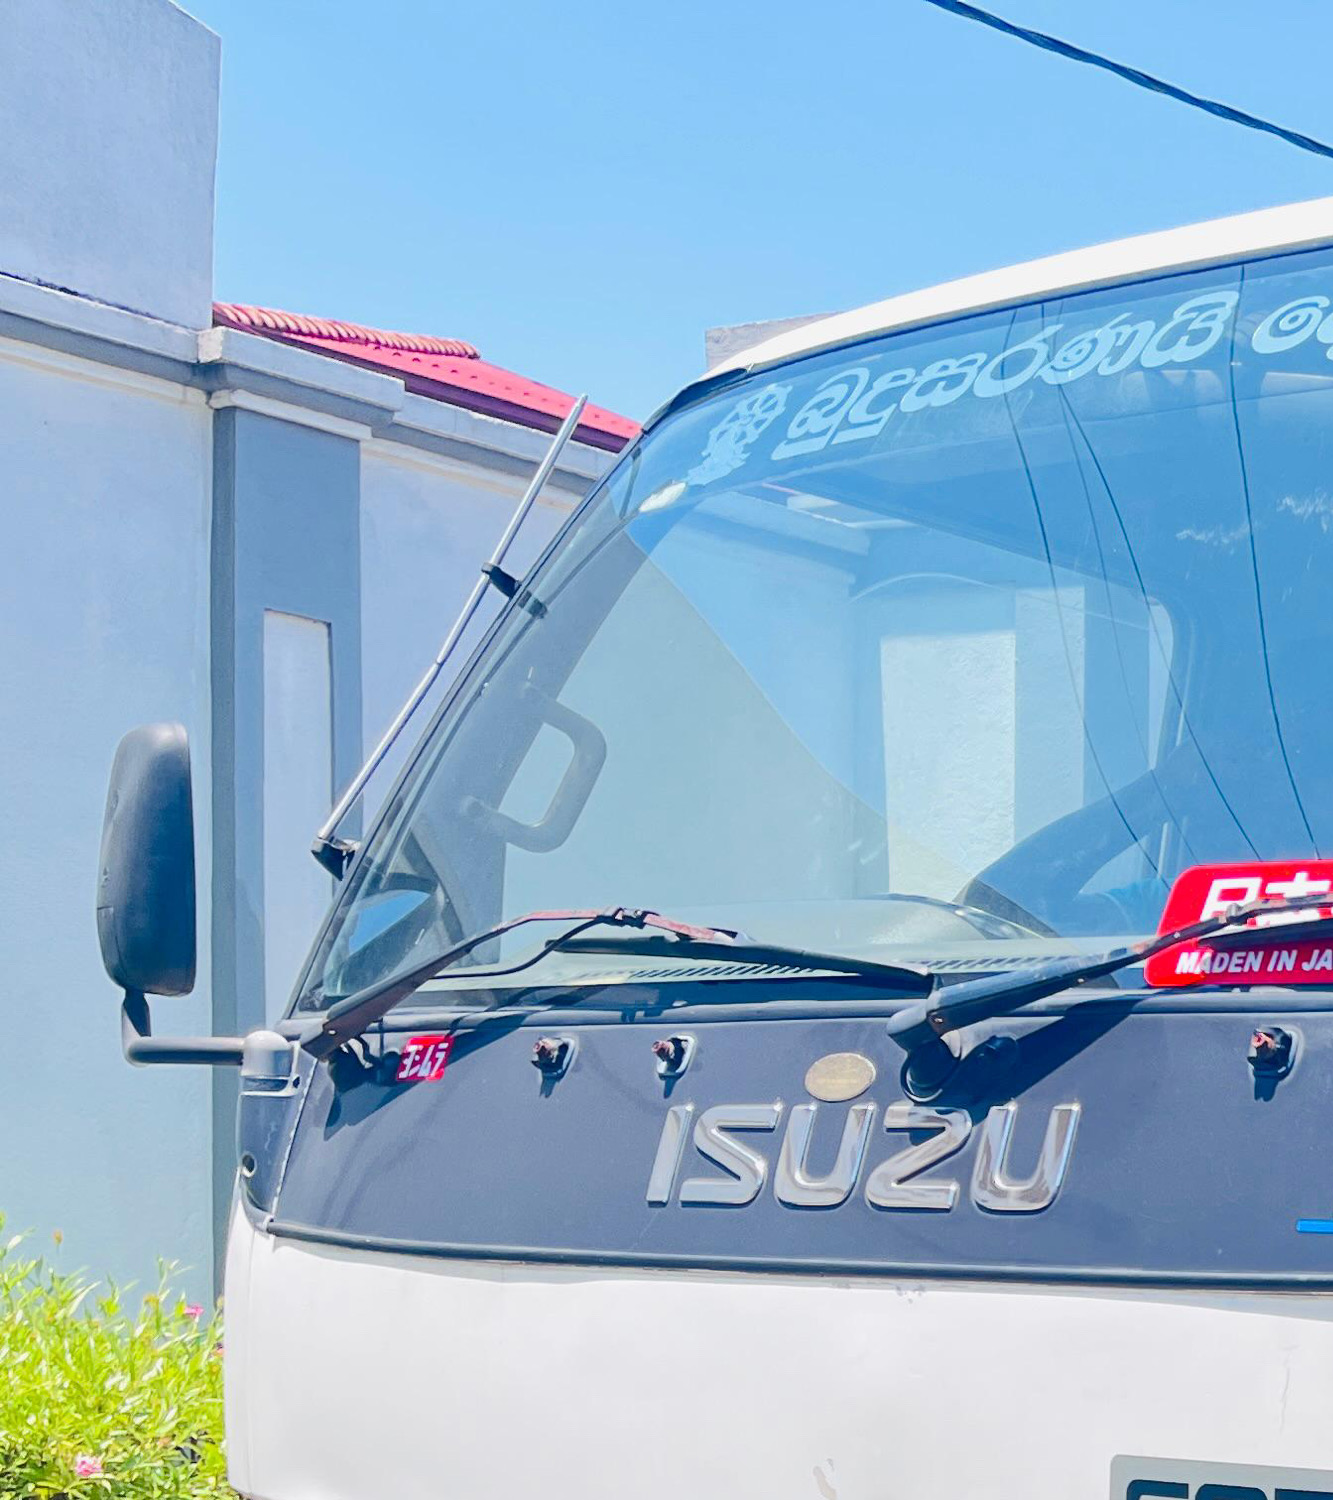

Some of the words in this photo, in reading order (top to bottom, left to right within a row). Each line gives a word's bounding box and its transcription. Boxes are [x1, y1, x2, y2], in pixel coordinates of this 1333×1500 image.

[1175, 949, 1263, 974] MADEN
[1267, 949, 1299, 971] IN
[646, 1099, 1082, 1212] ISUZU
